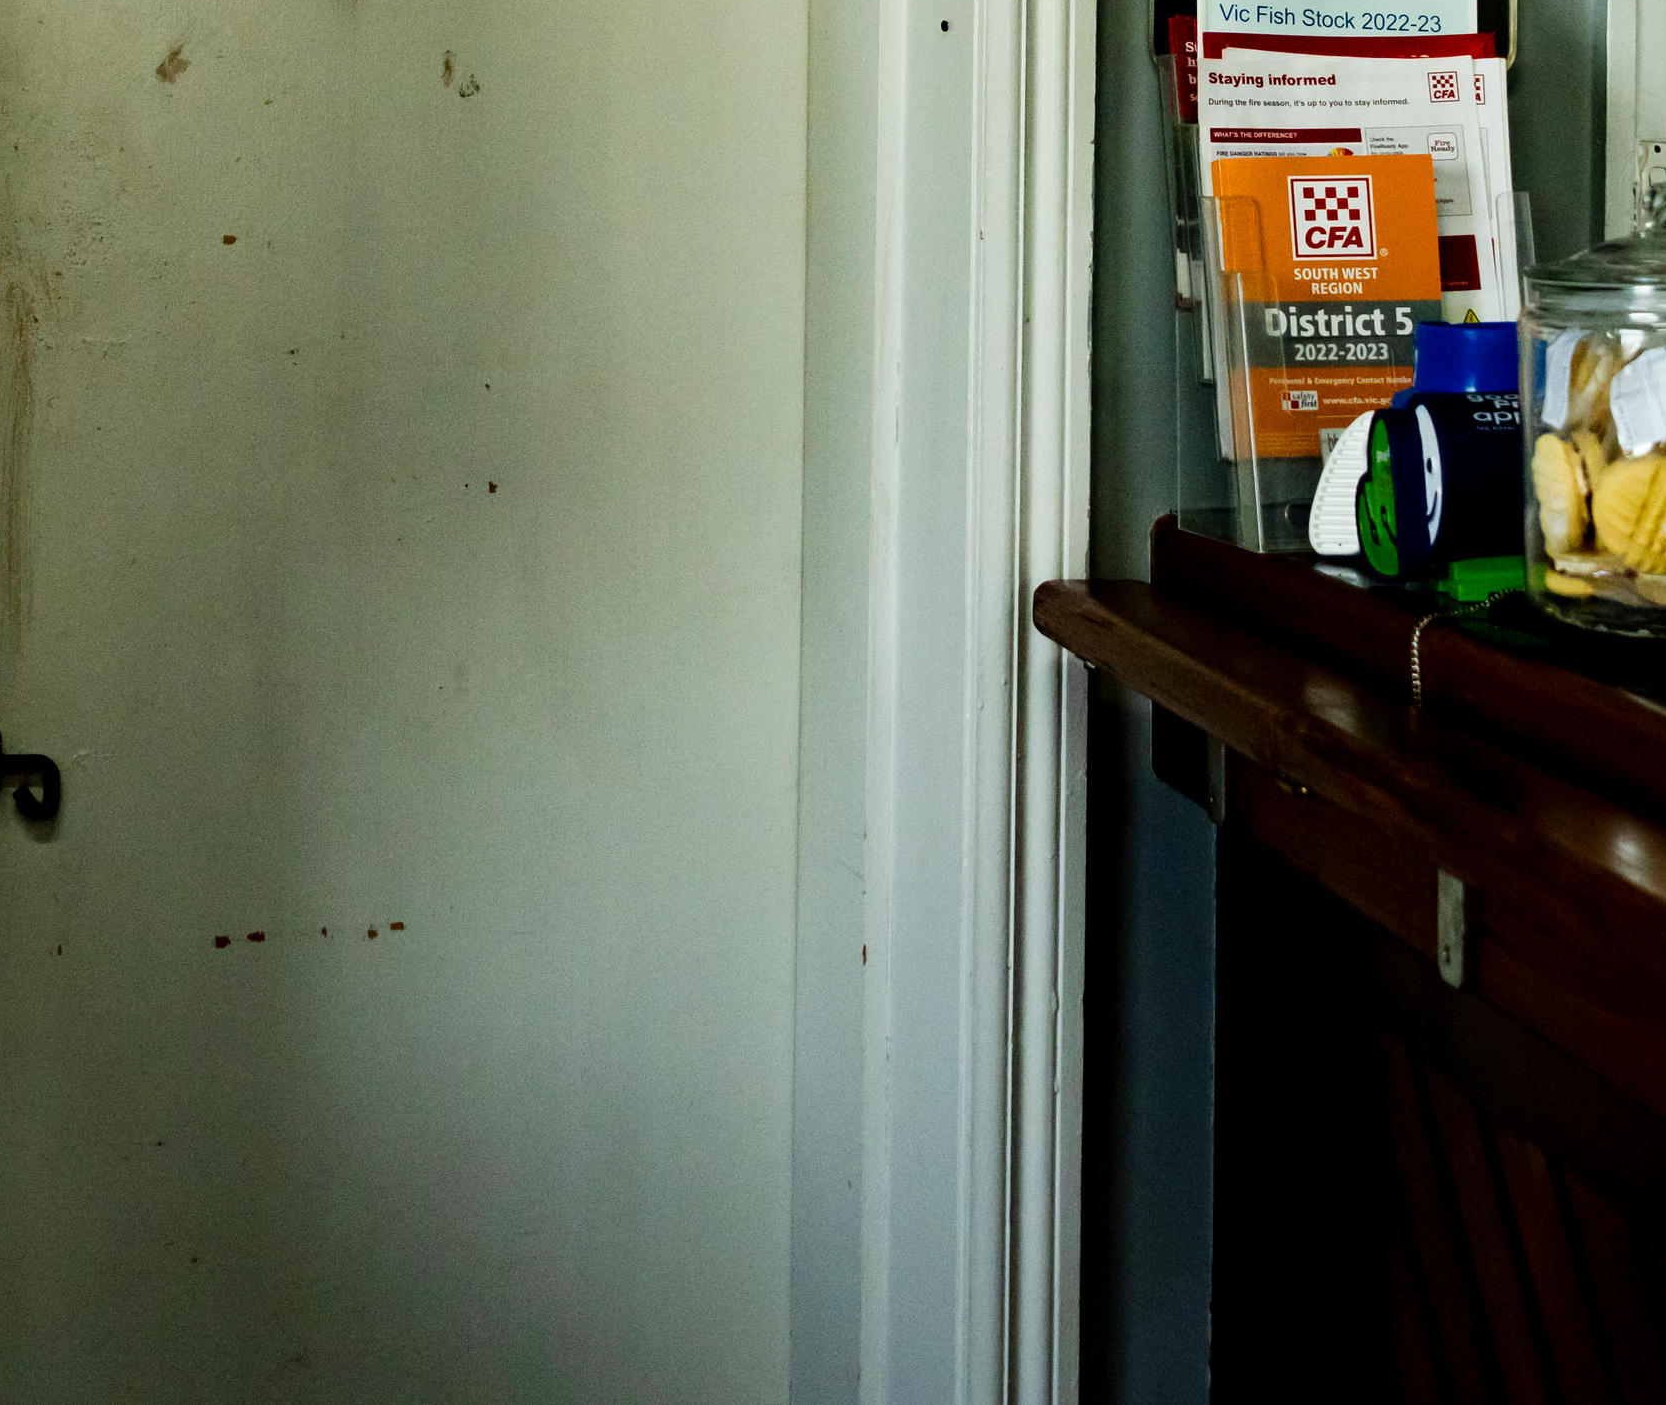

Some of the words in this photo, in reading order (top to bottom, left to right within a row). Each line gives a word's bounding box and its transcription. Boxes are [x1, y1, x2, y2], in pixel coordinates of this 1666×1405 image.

[1220, 4, 1250, 23] Vic
[1256, 6, 1296, 25] Fish
[1302, 9, 1355, 29] Stock
[1362, 13, 1442, 33] 2022-23
[1208, 72, 1264, 88] Staying
[1269, 74, 1336, 86] informed
[1433, 90, 1455, 100] CFA
[1304, 226, 1364, 249] CFA
[1294, 268, 1338, 280] SOUTH
[1342, 267, 1378, 279] WEST
[1311, 282, 1363, 294] REGION
[1265, 306, 1385, 336] District
[1395, 307, 1413, 335] 5
[1295, 343, 1389, 361] 2022-2023
